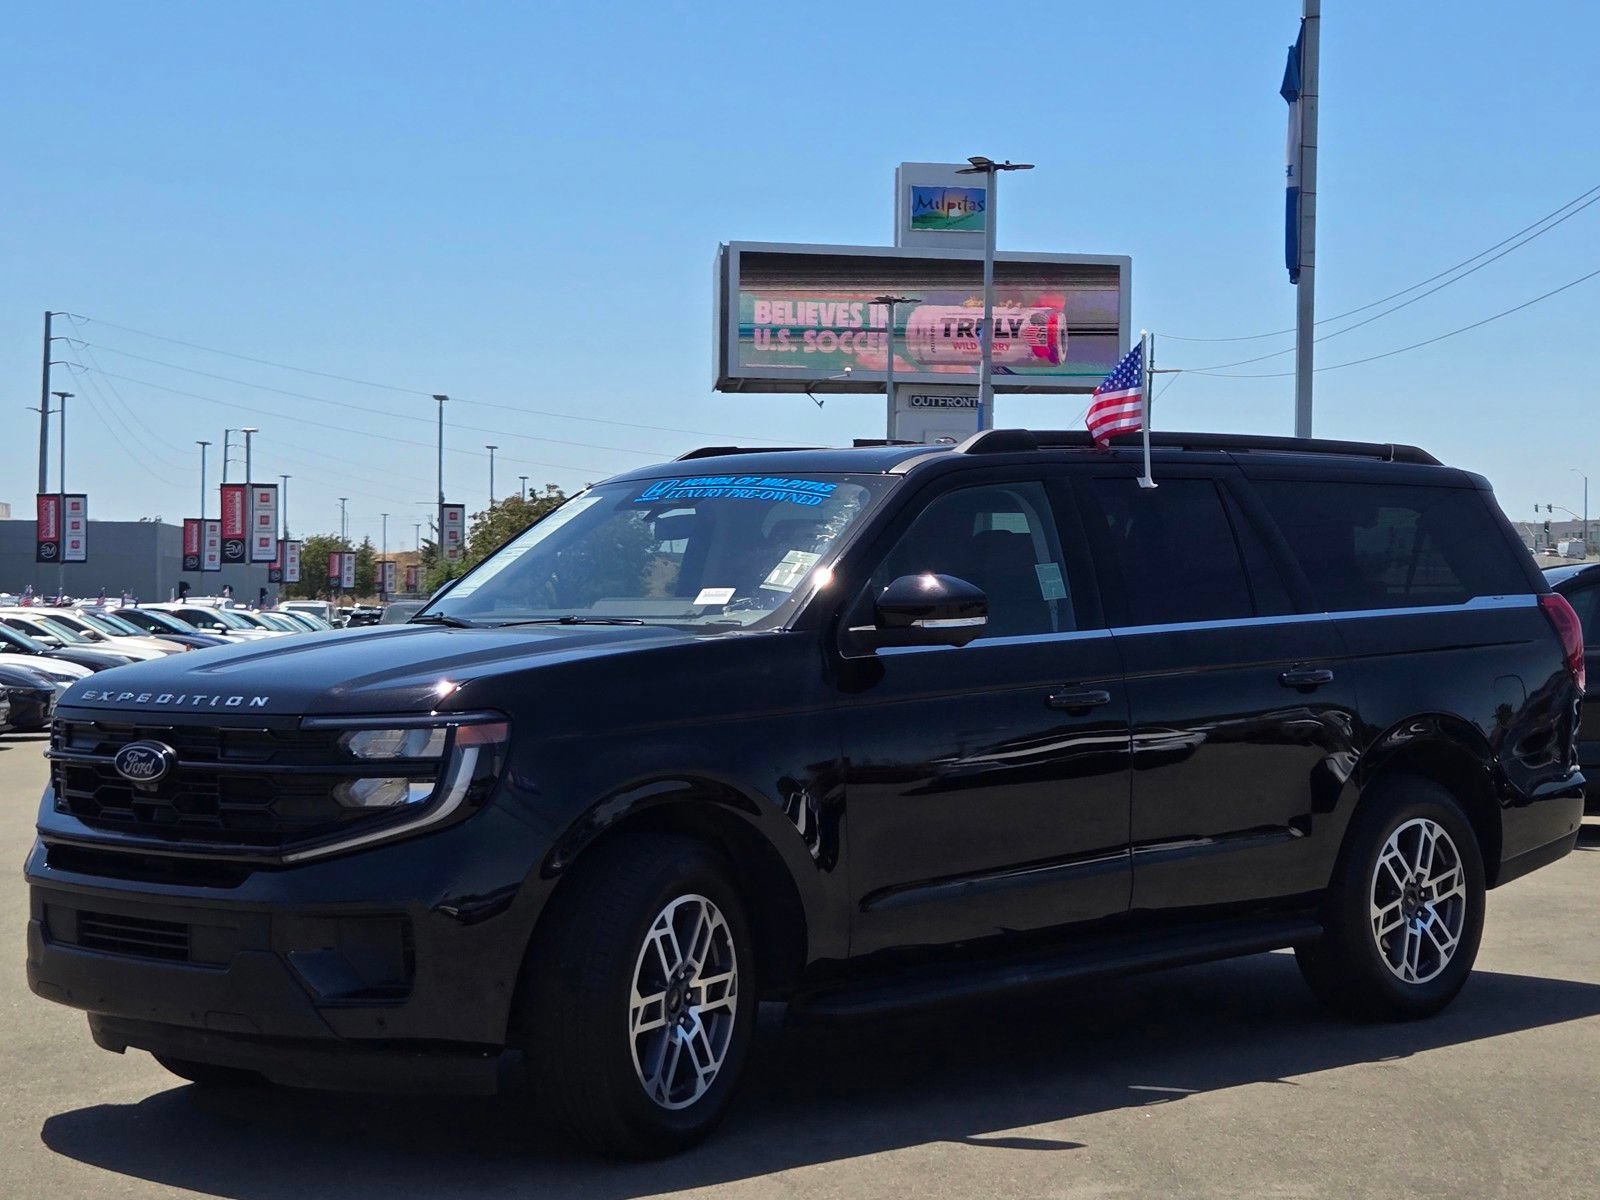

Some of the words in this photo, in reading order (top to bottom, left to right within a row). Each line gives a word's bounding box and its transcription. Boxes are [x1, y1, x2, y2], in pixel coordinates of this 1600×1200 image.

[914, 189, 985, 219] Milpitas
[754, 300, 863, 328] BELIEVES
[754, 328, 798, 352] U.S.
[952, 341, 978, 351] WILD
[912, 396, 979, 407] OUTFRONT
[678, 477, 735, 487] HONDA
[734, 477, 762, 486] OF
[756, 478, 837, 492] MILPITAS
[665, 488, 727, 499] LUXURY
[727, 488, 823, 506] PRE-OWNED
[82, 690, 269, 707] EXPEDITION
[123, 750, 155, 775] Ford
